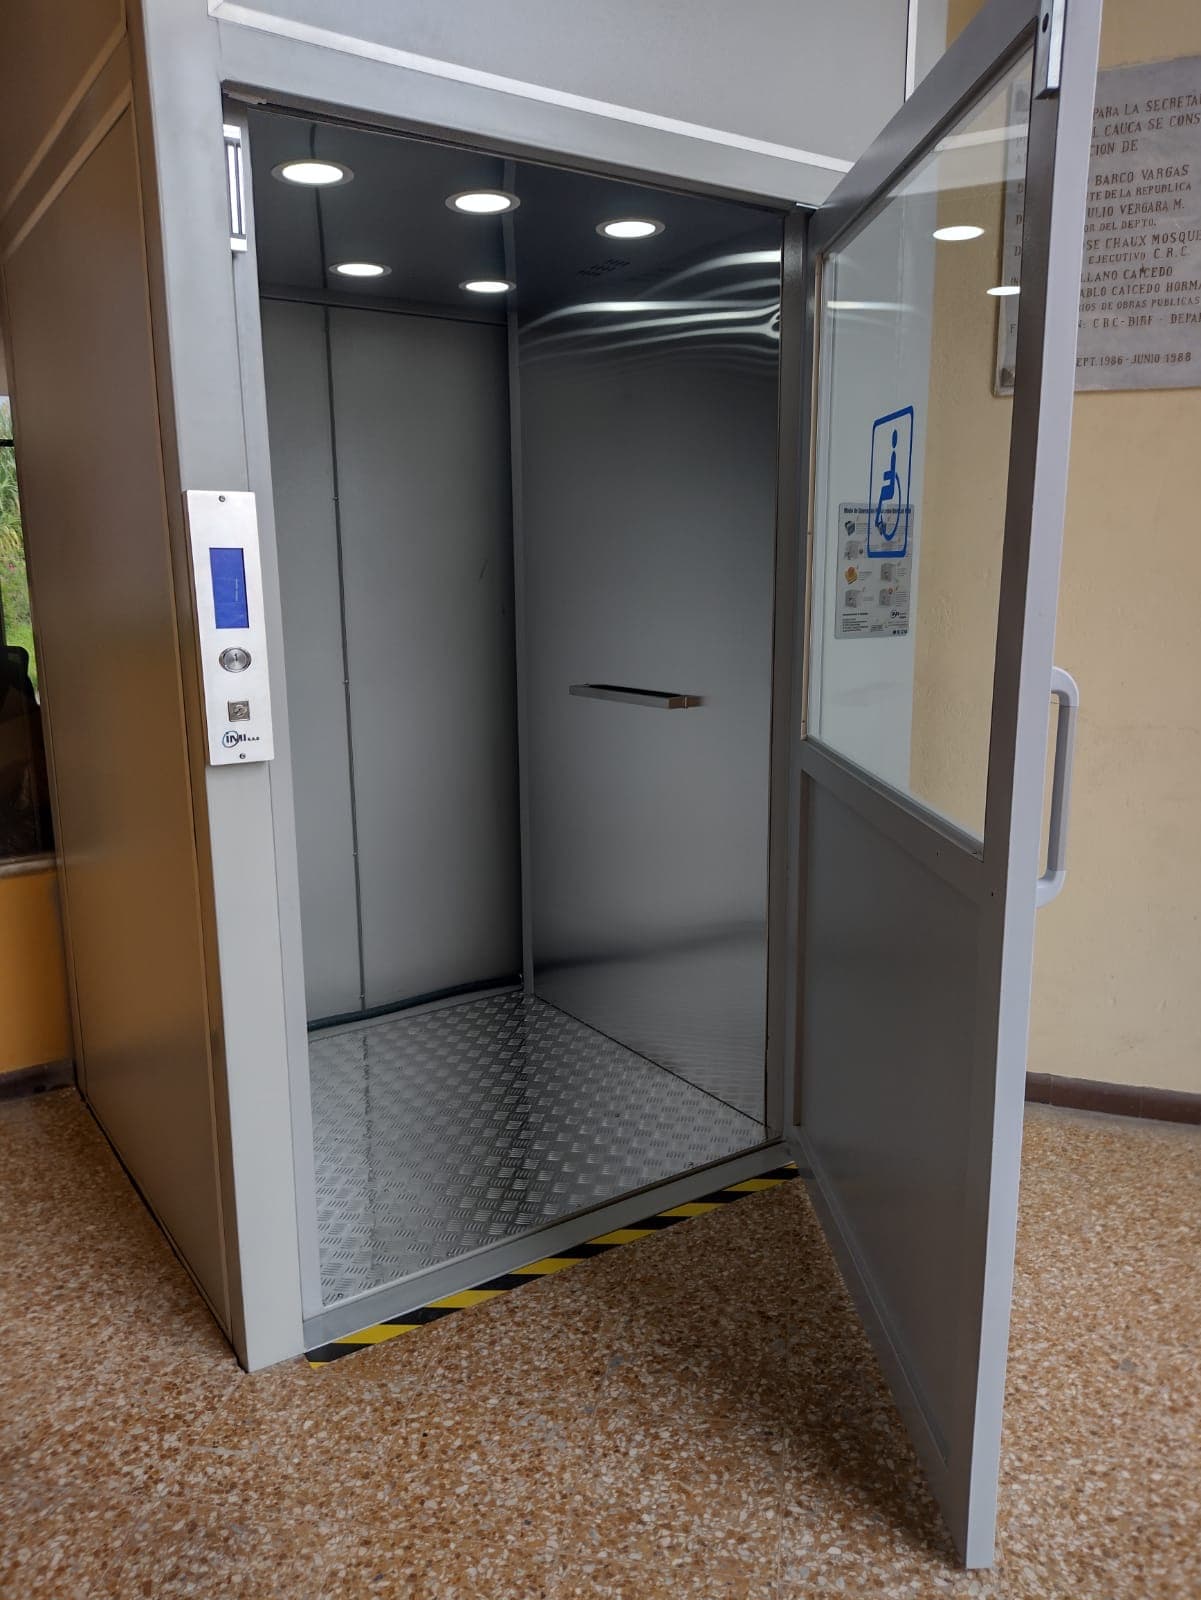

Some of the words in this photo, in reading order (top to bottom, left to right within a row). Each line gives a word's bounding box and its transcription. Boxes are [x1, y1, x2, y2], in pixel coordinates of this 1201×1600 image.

[1124, 103, 1140, 115] LA
[1145, 94, 1201, 112] SECRETA
[1104, 121, 1142, 136] CAUCA
[1147, 117, 1163, 130] SE
[1122, 139, 1138, 153] DE
[1095, 171, 1134, 186] BARCO
[1141, 164, 1190, 180] VARGAS
[1104, 189, 1117, 199] DE
[1120, 189, 1132, 198] LA
[1135, 182, 1192, 196] REPUBLICA
[1120, 199, 1169, 215] VERGARA
[1173, 198, 1185, 211] M.
[1099, 221, 1118, 232] DEL
[1121, 218, 1157, 230] DEPTO.
[1105, 234, 1147, 249] CHAUX
[1088, 251, 1147, 265] EJECUTIVO
[1123, 265, 1173, 281] CAICEDO
[1111, 282, 1161, 296] CAICEDO
[1101, 301, 1114, 311] DE
[1116, 299, 1148, 310] OBRAS
[1151, 296, 1201, 308] PUBLICAS
[1130, 353, 1161, 365] JUNIO
[1164, 351, 1193, 364] 1988
